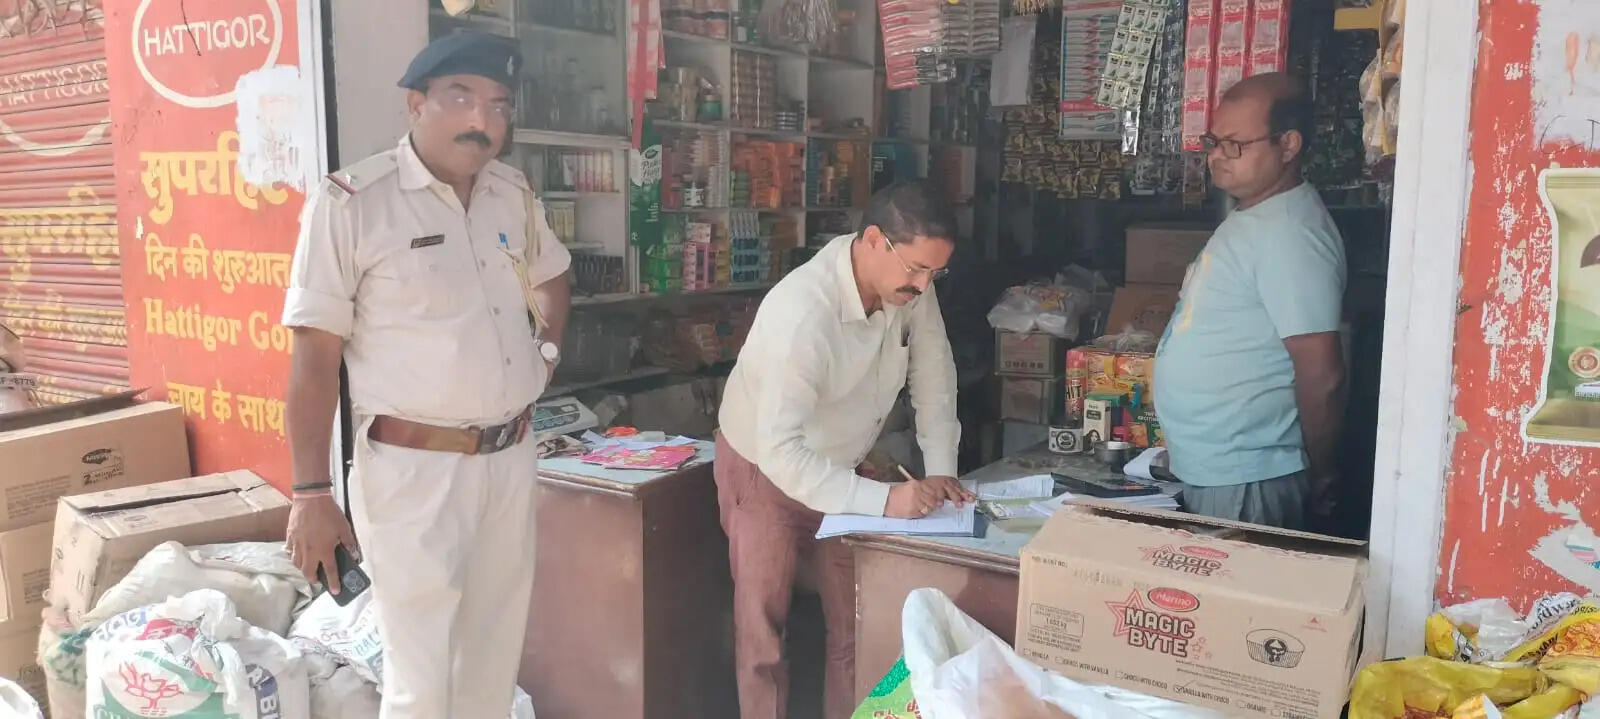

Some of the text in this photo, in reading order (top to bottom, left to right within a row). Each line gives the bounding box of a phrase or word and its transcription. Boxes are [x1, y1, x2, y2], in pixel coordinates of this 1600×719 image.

[143, 14, 271, 57] HATTIGOR
[145, 233, 178, 279] दिन
[182, 233, 208, 280] की
[143, 297, 242, 352] Hattigor
[211, 379, 231, 425] के
[237, 394, 287, 437] साथ
[1151, 559, 1213, 577] BYTE
[1152, 549, 1222, 570] MAGIC
[1125, 606, 1196, 639] MAGIC
[1128, 626, 1188, 658] BYTE
